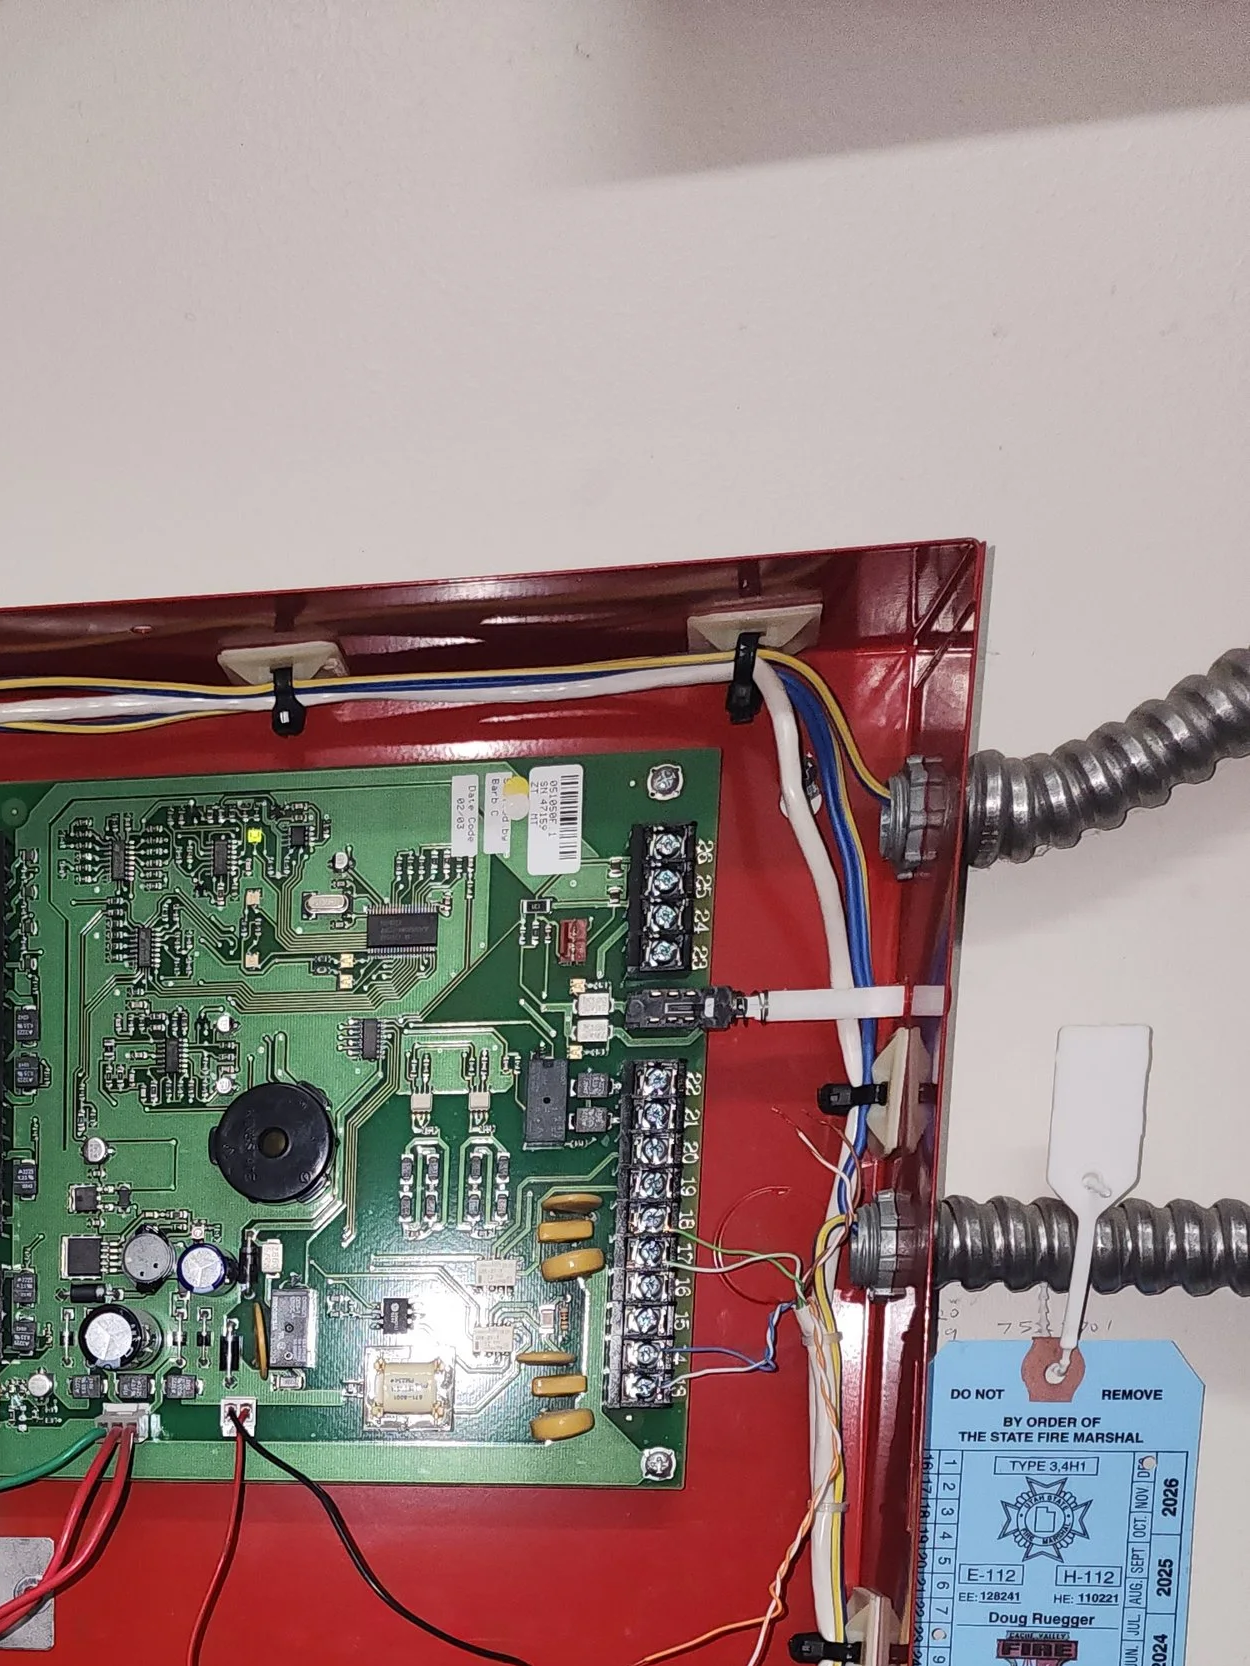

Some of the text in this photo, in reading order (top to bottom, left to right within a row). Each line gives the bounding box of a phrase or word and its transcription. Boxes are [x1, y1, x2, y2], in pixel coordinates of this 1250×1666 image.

[540, 781, 548, 794] SN
[456, 798, 465, 830] 02/03
[467, 786, 476, 842] Date Code
[694, 839, 714, 865] 26
[695, 874, 713, 898] 25
[693, 909, 710, 935] 24
[690, 946, 708, 971] 23
[681, 1175, 698, 1197] 19
[950, 1388, 1005, 1400] DO NOT
[1101, 1389, 1163, 1401] REMOVE
[1003, 1416, 1102, 1428] BY ORDER OF
[958, 1431, 1144, 1444] THE STATE FIRE MARSHAL
[1009, 1460, 1086, 1473] TYPE 3,4H1
[1163, 1477, 1179, 1517] 2026
[967, 1567, 1016, 1585] E-112
[1063, 1569, 1115, 1585] H-112
[1157, 1558, 1174, 1597] 2025
[958, 1591, 1020, 1602] EE: 128241
[1053, 1592, 1119, 1604] HE: 110221
[989, 1612, 1095, 1627] Doug Ruegger
[1001, 1643, 1073, 1657] FIRE
